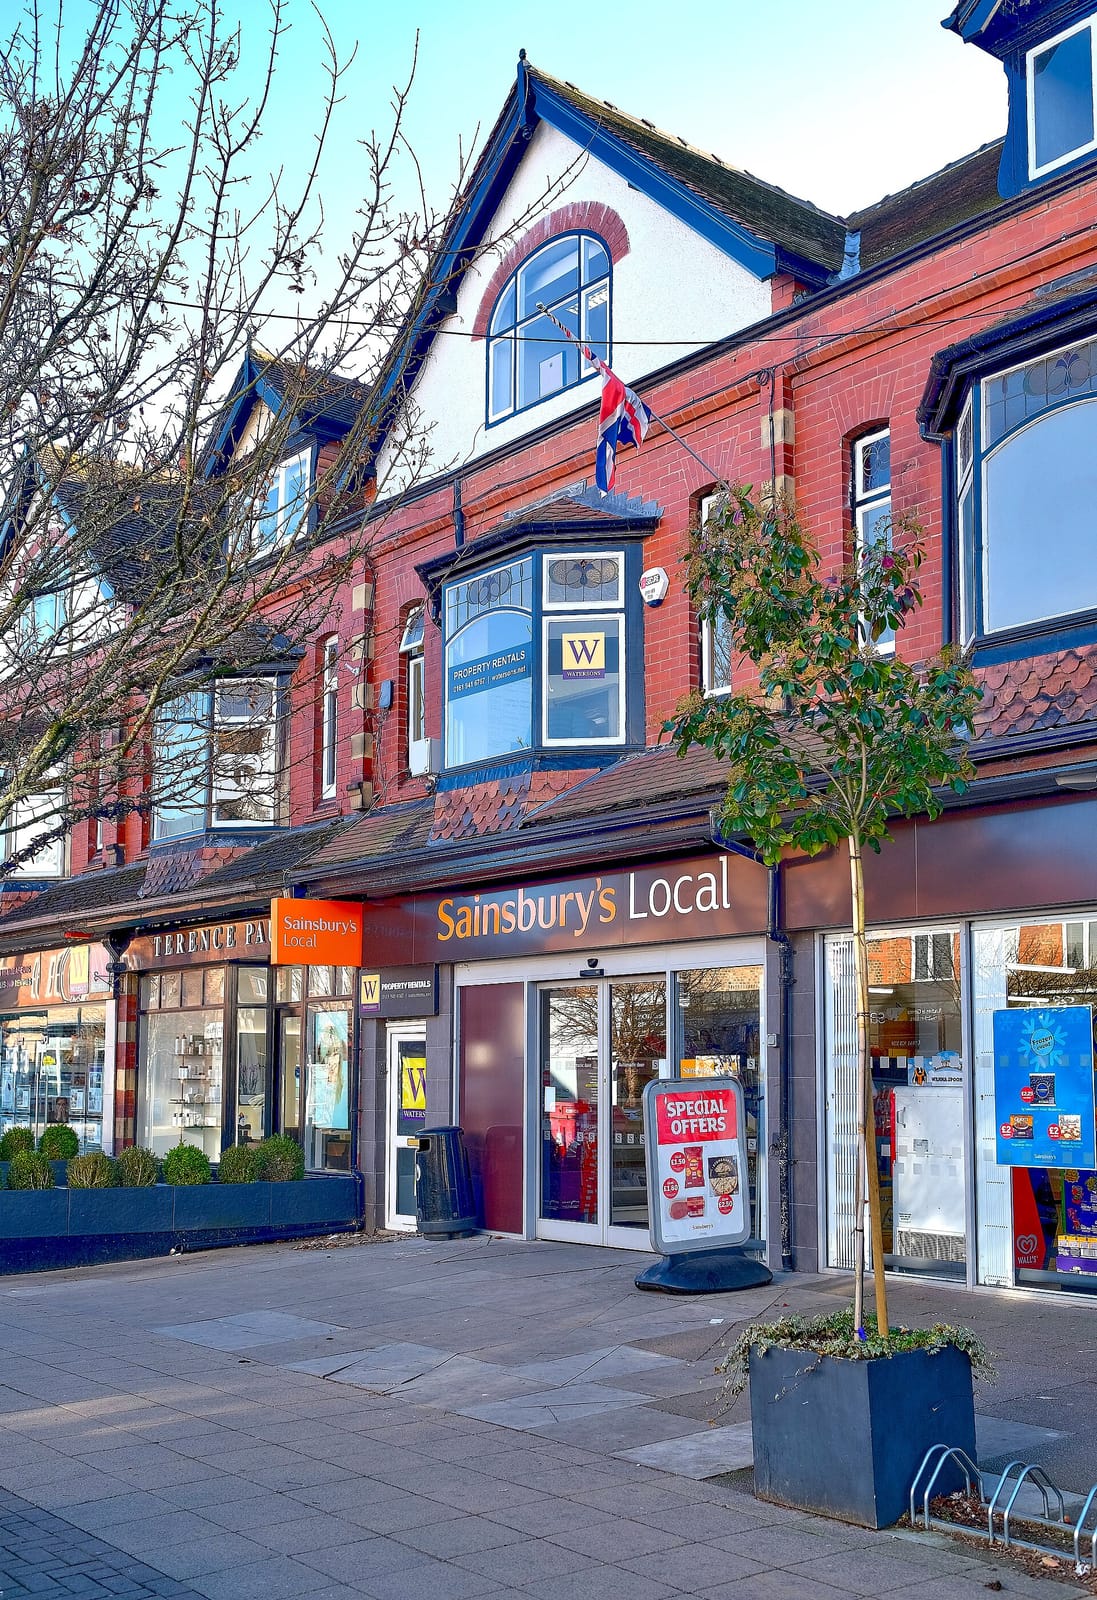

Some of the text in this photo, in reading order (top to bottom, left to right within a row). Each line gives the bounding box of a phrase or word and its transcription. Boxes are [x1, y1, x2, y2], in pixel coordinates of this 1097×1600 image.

[567, 639, 600, 664] W
[453, 650, 526, 680] PROPERTY RENTALS
[437, 855, 731, 941] Sainsbury's Local
[283, 915, 357, 935] Sainsbury's
[153, 925, 236, 957] TERENCE
[283, 933, 317, 948] Local
[363, 980, 377, 1000] W
[381, 980, 432, 990] PROPERTY RENTALS
[1031, 1035, 1053, 1046] Frozen
[406, 1068, 426, 1102] W
[666, 1099, 728, 1118] SPECIAL
[671, 1116, 726, 1135] OFFERS
[1001, 1125, 1011, 1134] £2
[1049, 1126, 1059, 1135] £2
[1018, 1256, 1037, 1264] WALL'S
